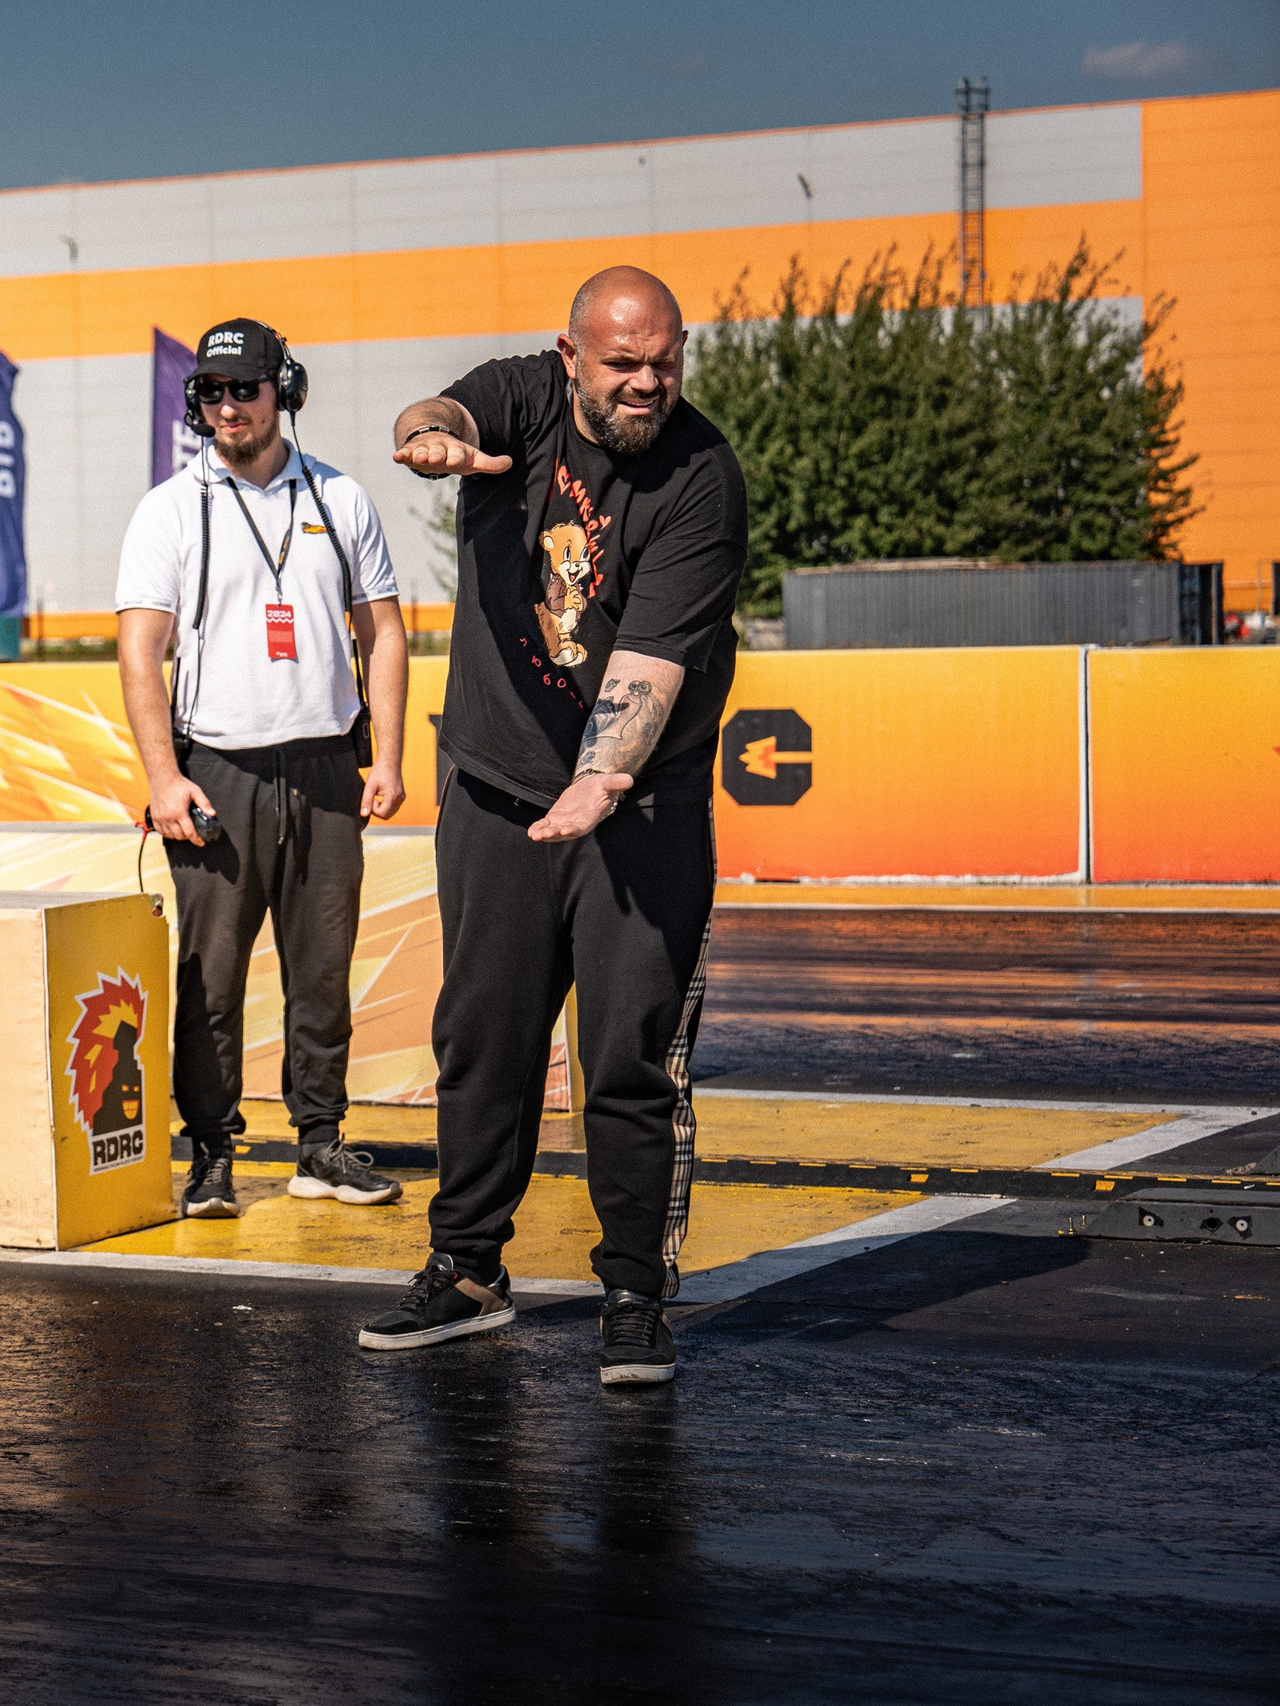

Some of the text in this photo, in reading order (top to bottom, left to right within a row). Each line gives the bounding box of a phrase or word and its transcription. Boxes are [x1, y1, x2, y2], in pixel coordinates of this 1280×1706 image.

[208, 331, 244, 347] RDRC
[266, 610, 293, 619] 2024
[92, 1130, 144, 1167] RDRC
